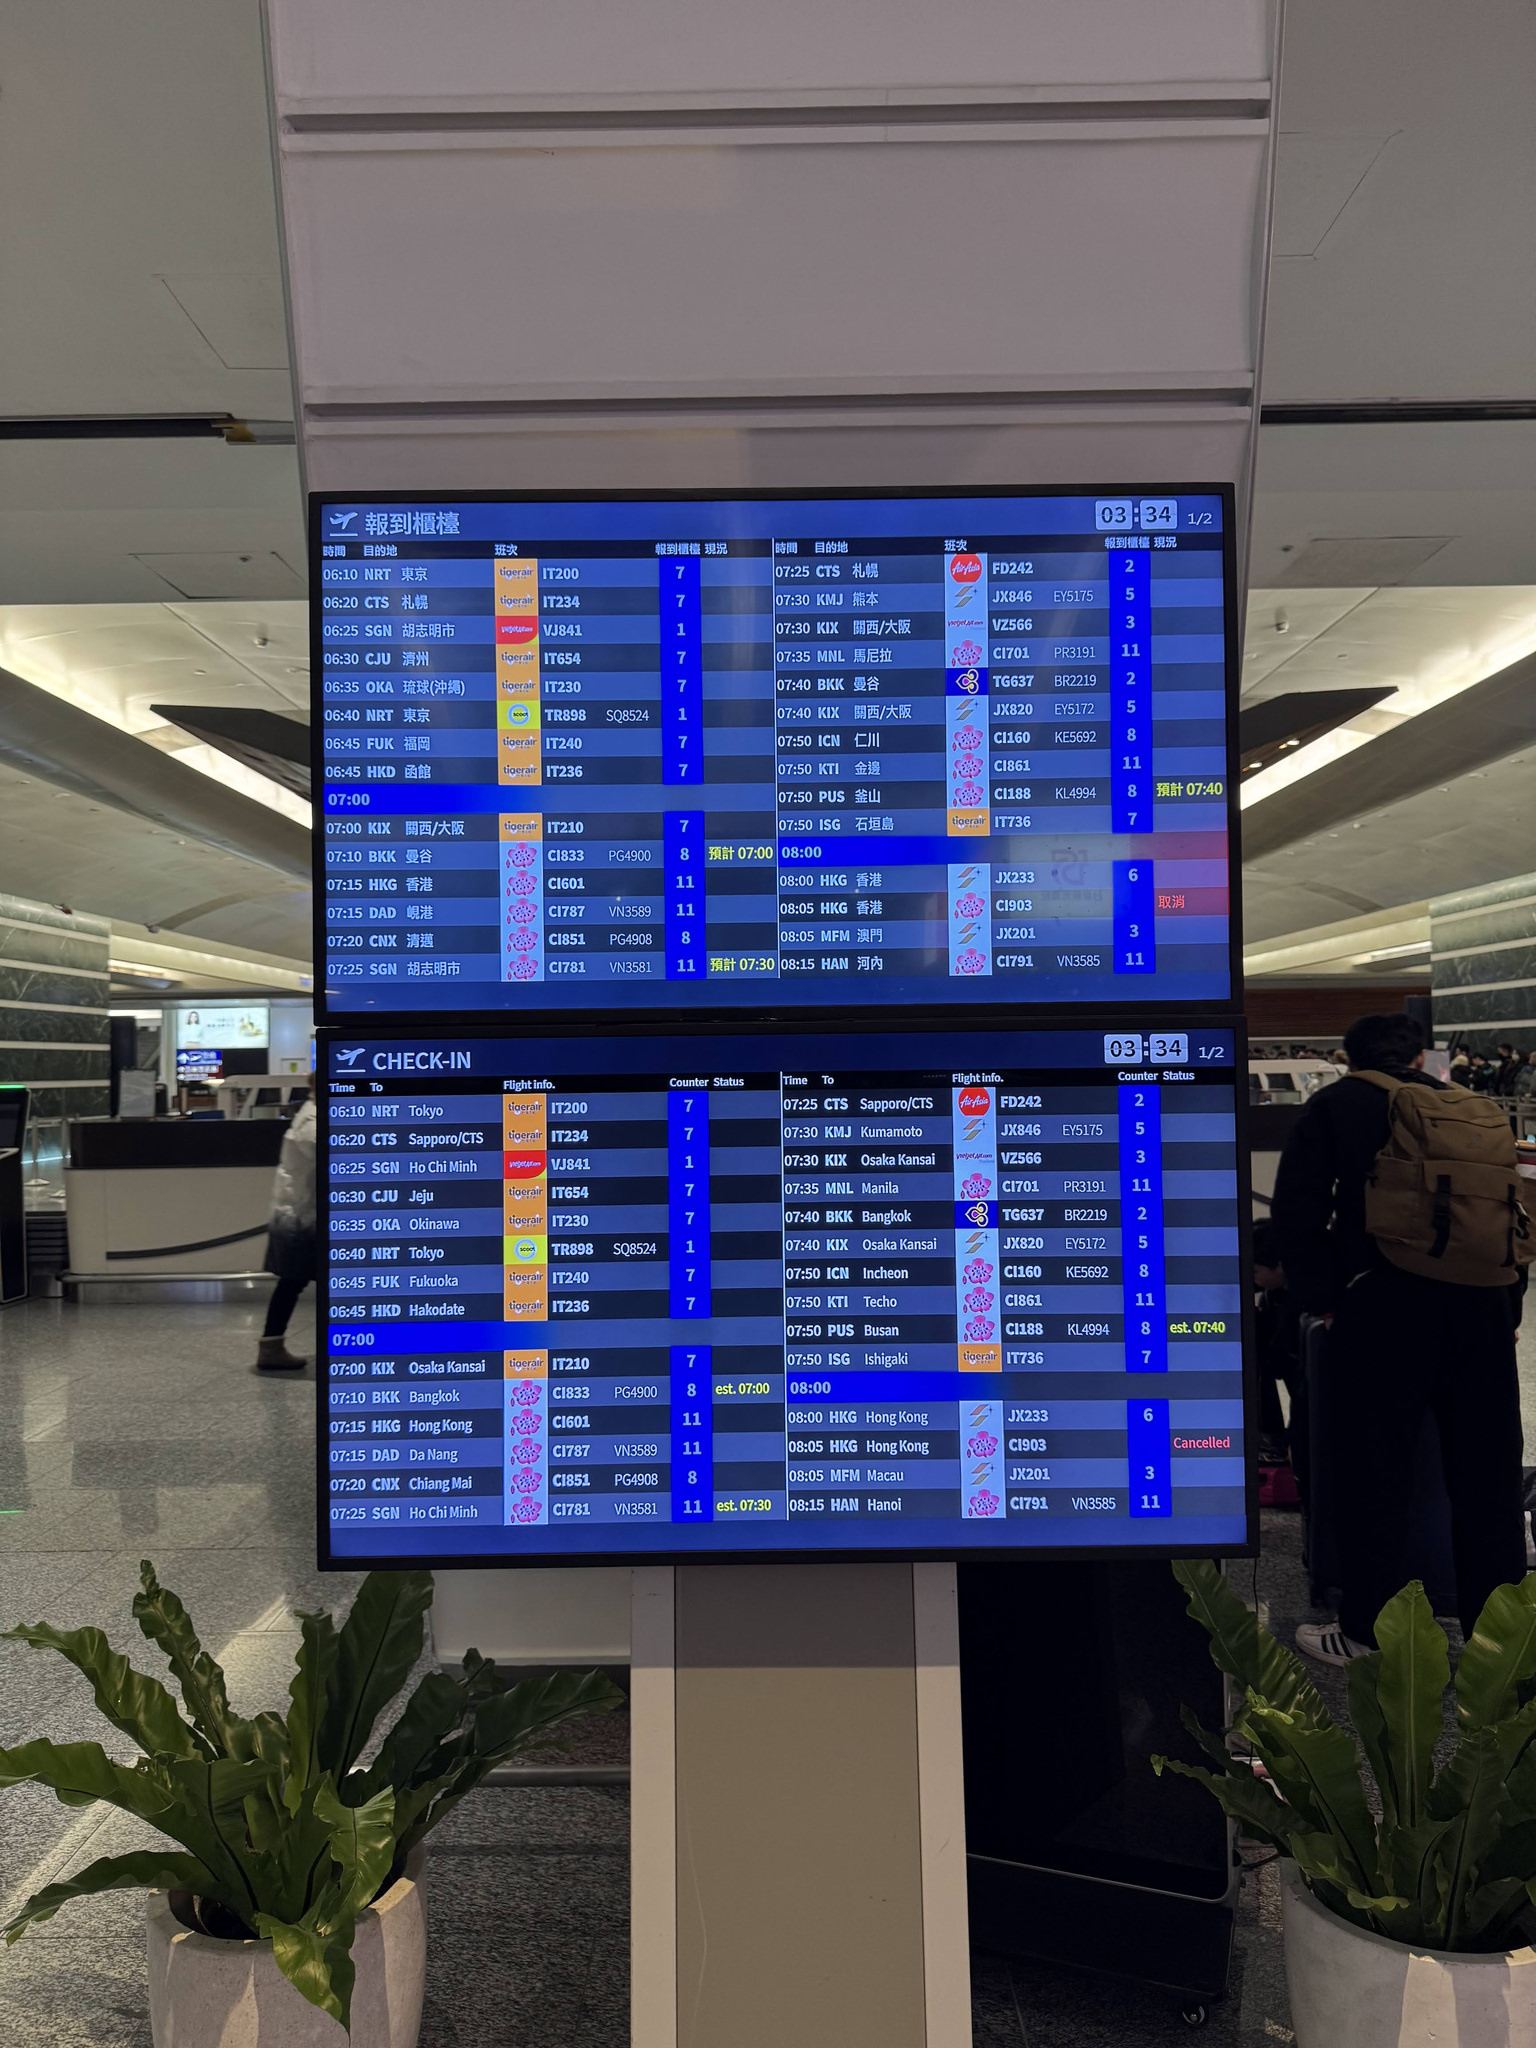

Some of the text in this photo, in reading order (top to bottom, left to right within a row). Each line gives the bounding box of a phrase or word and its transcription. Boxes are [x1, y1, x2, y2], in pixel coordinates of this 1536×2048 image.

[1100, 506, 1172, 524] 03:34
[1188, 513, 1212, 525] 1/2
[322, 545, 346, 558] 時間
[364, 544, 398, 557] 目的地
[495, 544, 519, 556] 班次
[704, 542, 728, 555] 現況
[775, 542, 798, 555] 時間
[815, 541, 849, 554] 目的地
[944, 539, 968, 551] 班次
[1153, 536, 1177, 549] 現況
[322, 569, 358, 580] 06:10
[365, 568, 391, 580] NRT
[401, 567, 427, 581] 東京
[543, 568, 579, 580] IT200
[675, 566, 685, 579] 7
[776, 587, 1135, 606] 07:30 KMJ 熊本 JX846 EY5175 5
[323, 623, 686, 637] 06:25 SGN 胡志明市 VJ841 1
[777, 672, 1136, 691] 07:40 BKK 曼谷 TG637 BR2219 2
[324, 709, 360, 721] 06:40
[366, 709, 394, 721] NRT
[403, 708, 430, 723] 東京
[544, 709, 586, 721] TR898
[606, 709, 649, 723] SQ8524
[678, 708, 687, 720] 1
[328, 793, 370, 806] 07:00
[778, 782, 1223, 803] 07:50 PUS 釜山 CI188 KL4994 8 預計 07:40
[326, 846, 773, 863] 07:10 BKK 曼谷 CI833 PG4900 8 預計 07:00
[782, 846, 822, 858] 08:00
[780, 895, 1184, 915] 08:05 HKG 香港 CI903 取消
[327, 936, 363, 947] 07:20
[369, 935, 397, 947] CNX
[548, 933, 586, 945] CI851
[610, 933, 652, 945] PG4908
[681, 931, 691, 944] 8
[1110, 1039, 1182, 1057] 03:34
[1199, 1046, 1225, 1059] 1/2
[373, 1052, 471, 1071] CHECK-IN
[329, 1077, 744, 1092] Time To Flight info. Counter Status
[783, 1070, 1195, 1085] Time To Flight info. Counter Status
[783, 1099, 818, 1110] 07:25
[824, 1098, 848, 1110] CTS
[860, 1097, 933, 1112] Sapporo/CTS
[1000, 1096, 1042, 1108] FD242
[1135, 1093, 1144, 1106] 2
[785, 1178, 1151, 1194] 07:35 MNL Manila CI701 PR3191 11
[329, 1220, 366, 1231] 06:35
[372, 1219, 400, 1231] OKA
[409, 1218, 459, 1230] Okinawa
[552, 1215, 589, 1227] IT230
[685, 1212, 695, 1225] 7
[786, 1264, 1149, 1280] 07:50 ICN Incheon CI160 KE5692 8
[787, 1321, 1226, 1337] 07:50 PUS Busan CI188 KL4994 8 est. 07:40
[332, 1333, 375, 1346] 07:00
[787, 1353, 822, 1365] 07:50
[828, 1353, 850, 1365] ISG
[865, 1352, 908, 1369] Ishigaki
[1007, 1352, 1043, 1364] IT736
[1141, 1350, 1151, 1363] 7
[790, 1381, 831, 1394] 08:00
[330, 1441, 702, 1463] 07:15 DAD Da Nang CI787 VN3589 11
[788, 1436, 1230, 1455] 08:05 HKG Hong Kong CI903 Cancelled
[330, 1499, 771, 1520] 07:25 SGN Ho Chi Minh CI781 VN3581 11 est. 07:30
